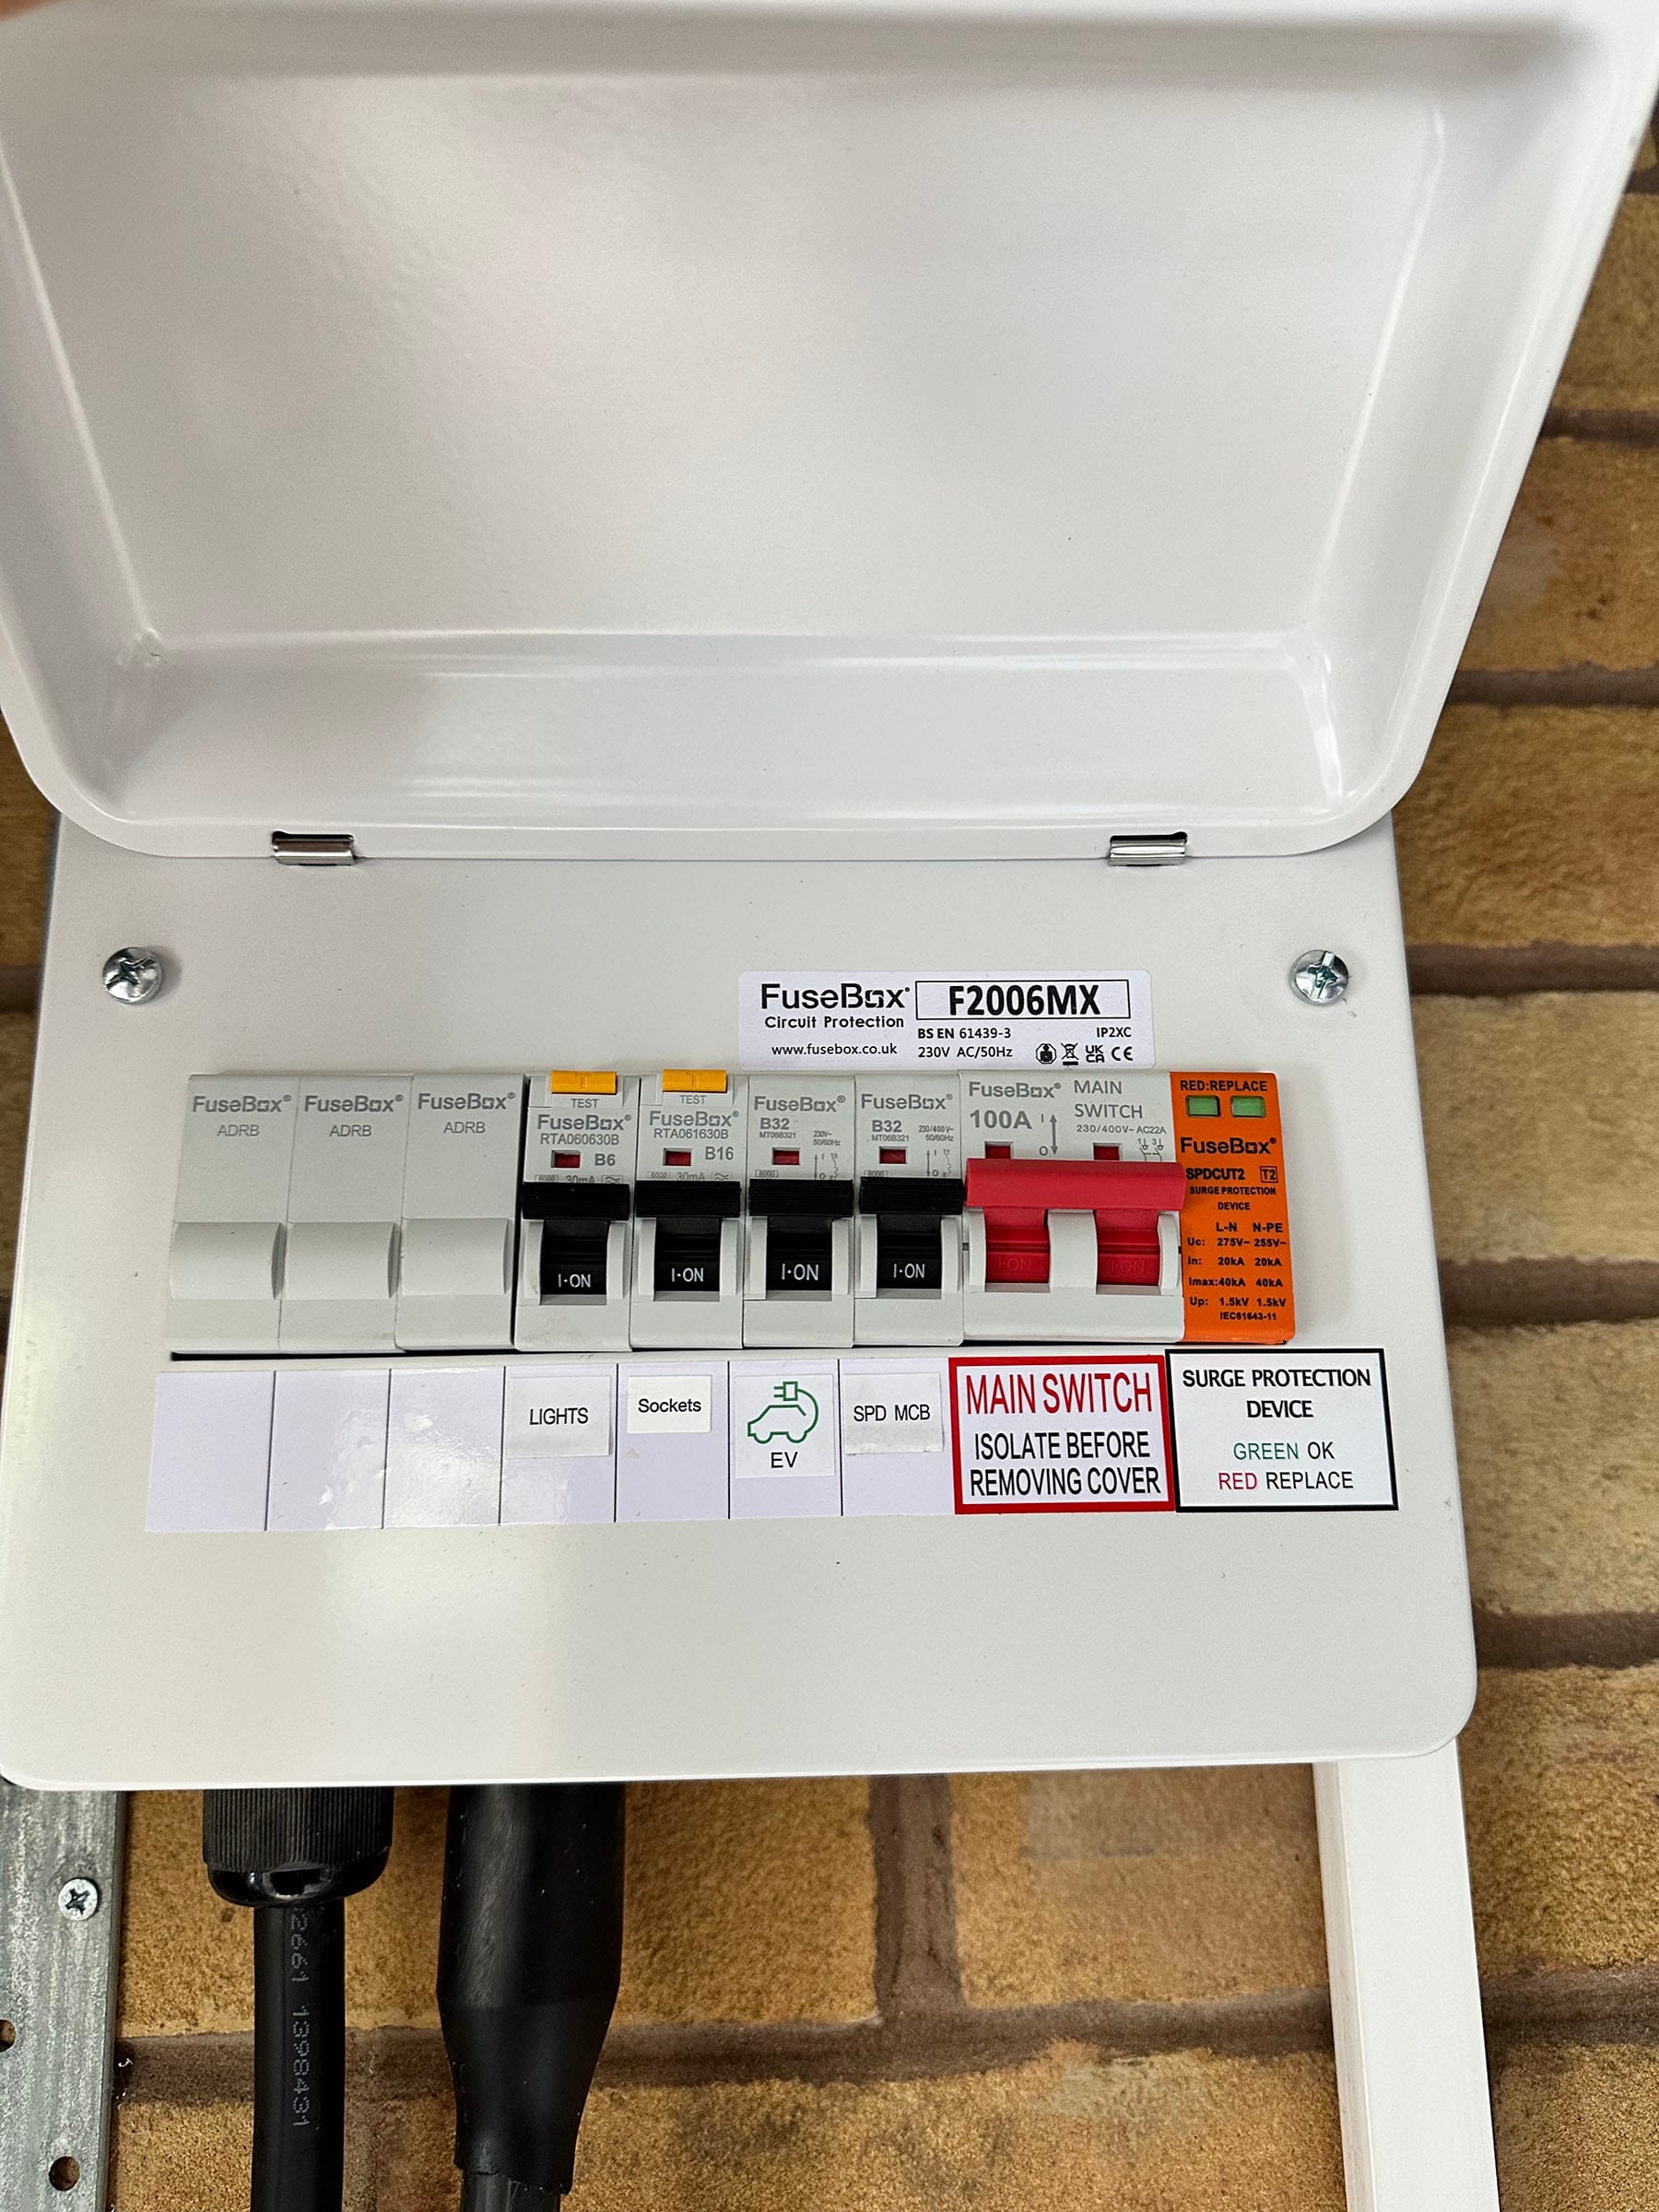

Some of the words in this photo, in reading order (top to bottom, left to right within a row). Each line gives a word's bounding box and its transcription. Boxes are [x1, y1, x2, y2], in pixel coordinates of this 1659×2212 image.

[948, 984, 1100, 1016] F2006MX
[764, 1015, 817, 1029] Circuit
[823, 1015, 904, 1029] Protection
[917, 1028, 935, 1039] BS
[937, 1028, 955, 1039] EN
[959, 1027, 1012, 1039] 61439-3
[1096, 1026, 1132, 1038] IP2XC
[771, 1041, 898, 1055] www.fusebox.co.uk
[917, 1046, 950, 1058] 230V
[957, 1045, 1014, 1059] AC/50Hz
[1074, 1080, 1123, 1094] MAIN
[1180, 1080, 1268, 1091] RED:REPLACE
[571, 1098, 599, 1109] TEST
[679, 1095, 706, 1105] TEST
[1074, 1103, 1143, 1119] SWITCH
[759, 1117, 791, 1131] B32
[872, 1120, 902, 1133] B32
[970, 1110, 1032, 1130] 100A
[218, 1124, 260, 1136] ADRB
[329, 1124, 372, 1136] ADRB
[443, 1122, 486, 1134] ADRB
[653, 1128, 729, 1139] RTA061630B
[1136, 1125, 1167, 1135] AC22A
[539, 1133, 620, 1146] RTA060630B
[594, 1153, 617, 1166] B6
[705, 1147, 735, 1160] B16
[1185, 1168, 1245, 1180] SPDCUT2
[1262, 1169, 1277, 1180] T2
[1189, 1186, 1219, 1194] SURGE
[1221, 1186, 1277, 1194] PROTECTION
[1218, 1202, 1251, 1210] DEVICE
[1216, 1222, 1238, 1232] L-N
[1253, 1223, 1284, 1232] N-PE
[1187, 1237, 1206, 1246] Uc:
[1187, 1256, 1202, 1265] In:
[1218, 1256, 1244, 1265] 20kA
[1254, 1257, 1282, 1266] 20kA
[1189, 1277, 1218, 1287] Imax:
[1218, 1277, 1246, 1287] 40kA
[1255, 1277, 1283, 1288] 40kA
[1190, 1296, 1208, 1308] Up:
[1218, 1297, 1249, 1307] 1.5kV
[1256, 1297, 1287, 1307] 1.5kV
[1219, 1312, 1277, 1321] IEC61643-11
[1182, 1370, 1245, 1387] SURGE
[1252, 1369, 1371, 1386] PROTECTION
[966, 1374, 1036, 1415] MAIN
[1043, 1372, 1153, 1412] SWITCH
[638, 1397, 701, 1414] Sockets
[1246, 1400, 1313, 1418] DEVICE
[529, 1407, 589, 1425] LIGHTS
[853, 1406, 887, 1422] SPD
[894, 1405, 930, 1421] MCB
[975, 1432, 1061, 1461] ISOLATE
[1066, 1431, 1150, 1458] BEFORE
[1233, 1442, 1299, 1460] GREEN
[1307, 1441, 1335, 1459] OK
[771, 1452, 798, 1468] EV
[971, 1468, 1082, 1496] REMOVING
[1088, 1466, 1161, 1494] COVER
[1218, 1472, 1258, 1489] RED
[1265, 1471, 1353, 1488] REPLACE
